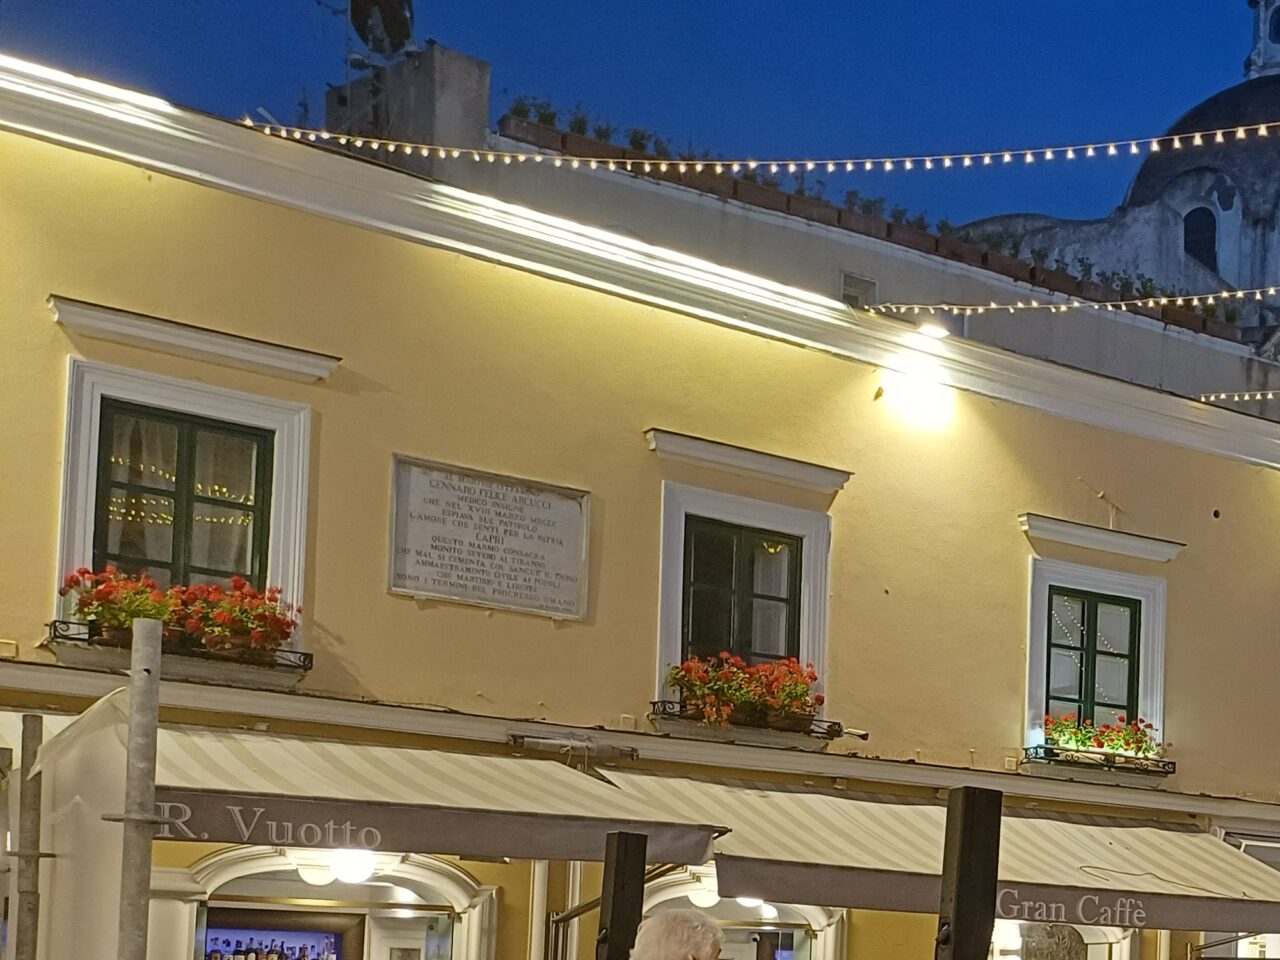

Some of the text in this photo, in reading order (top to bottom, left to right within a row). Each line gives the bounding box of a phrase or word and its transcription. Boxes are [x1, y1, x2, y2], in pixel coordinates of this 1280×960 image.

[458, 495, 487, 505] MEDICO
[495, 509, 526, 520] MARZO
[432, 536, 464, 546] QUESTO
[468, 542, 499, 552] MARMO
[476, 533, 504, 545] CAPRI
[431, 544, 463, 555] MONITO
[155, 802, 382, 849] R. Vuotto
[996, 888, 1147, 926] Gran Caffè
